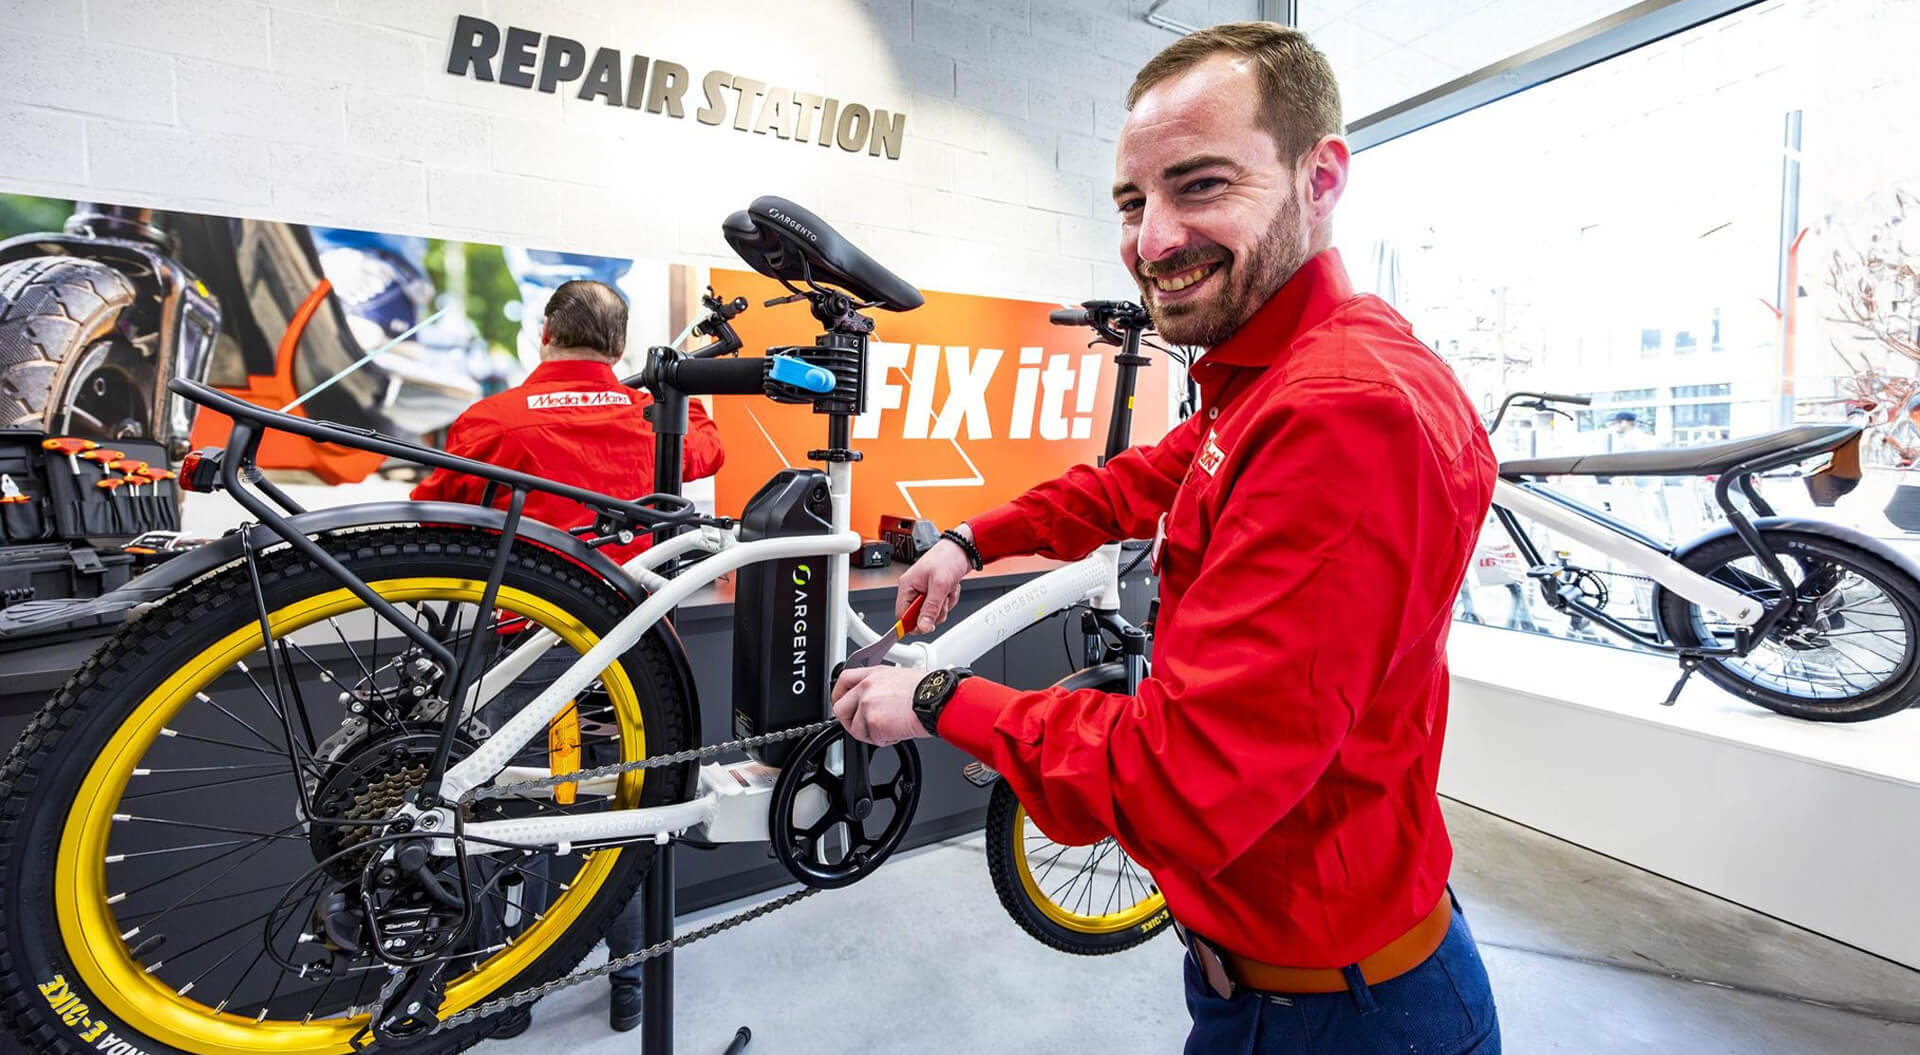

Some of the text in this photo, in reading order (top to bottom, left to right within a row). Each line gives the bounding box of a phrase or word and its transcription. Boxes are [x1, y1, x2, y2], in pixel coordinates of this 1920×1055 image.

[447, 14, 906, 161] REPAIR STATION
[778, 214, 817, 242] ARGENTO
[532, 393, 580, 407] Media
[852, 341, 1103, 440] FIX it!
[792, 589, 808, 695] ARGENTO
[37, 974, 109, 1043] E-BIKE
